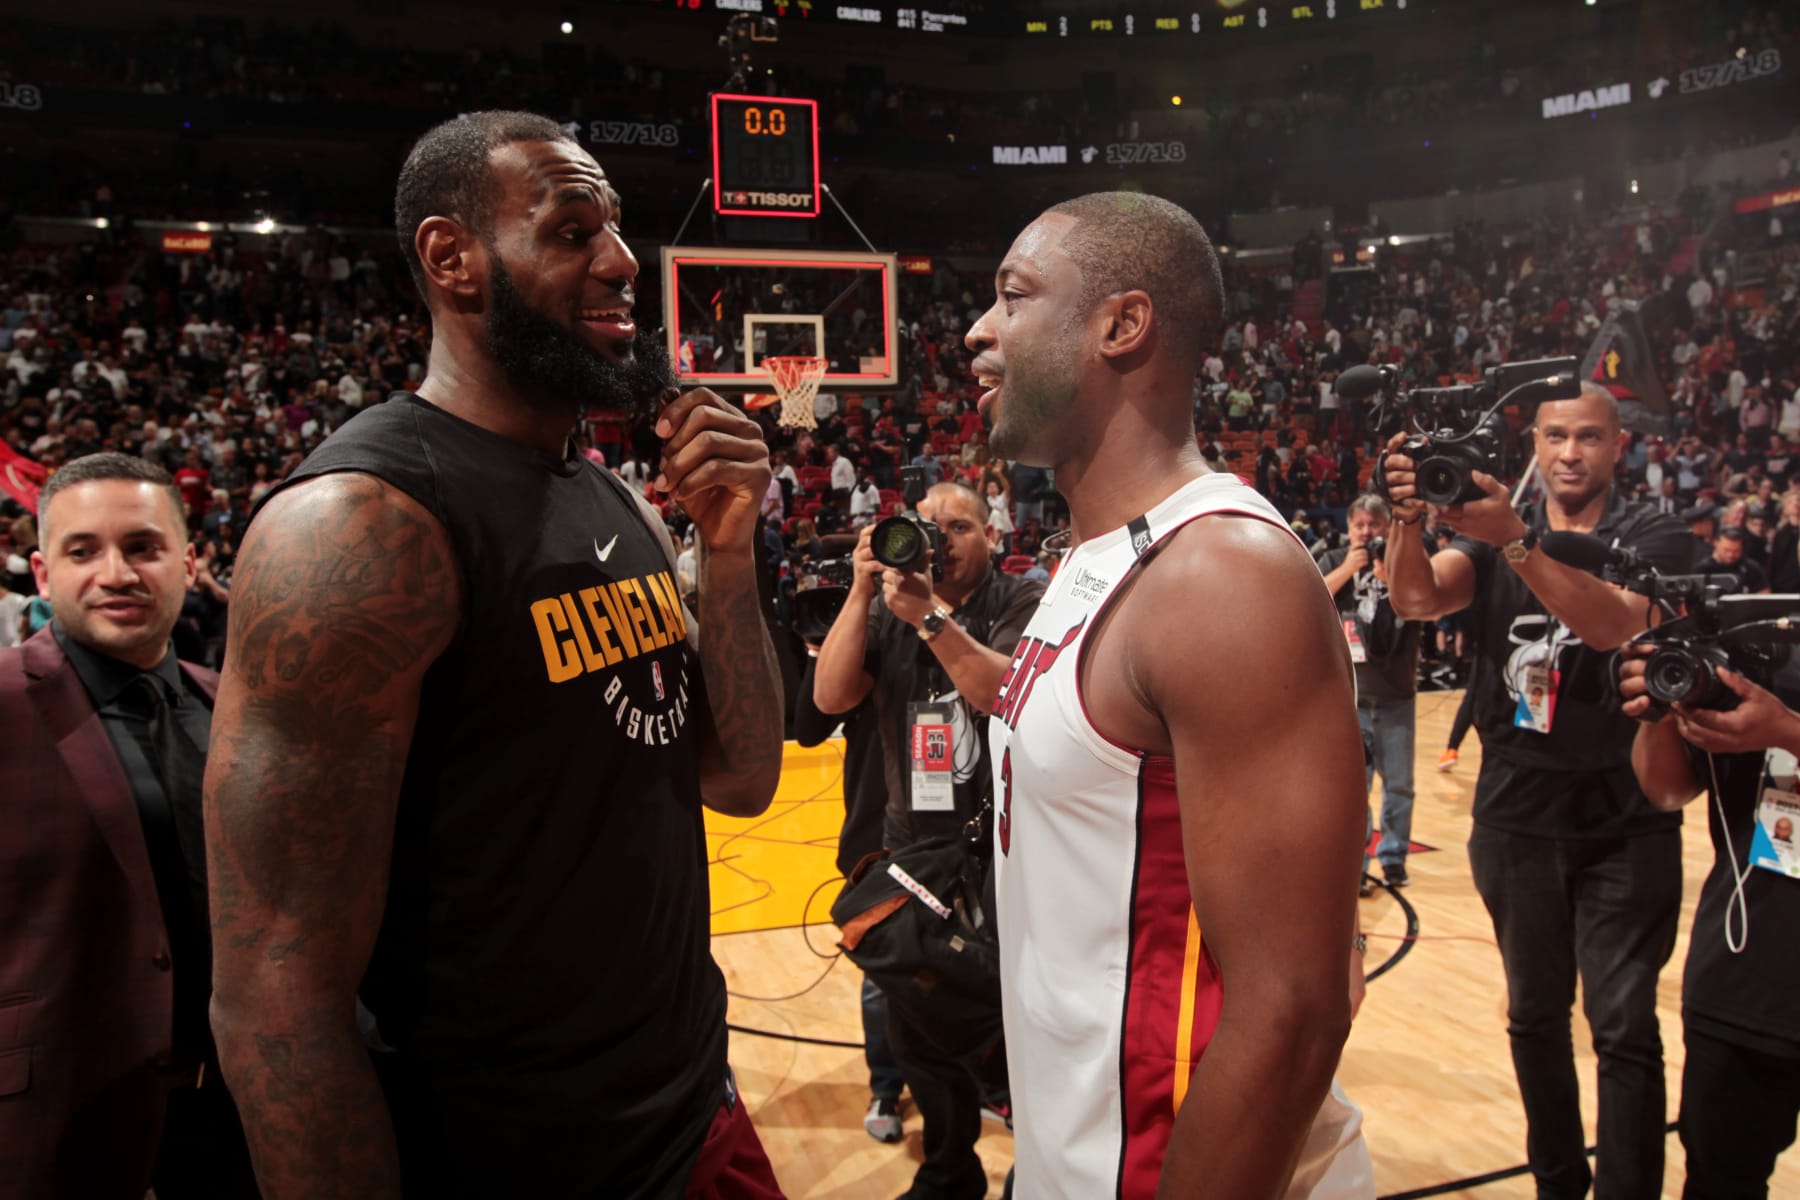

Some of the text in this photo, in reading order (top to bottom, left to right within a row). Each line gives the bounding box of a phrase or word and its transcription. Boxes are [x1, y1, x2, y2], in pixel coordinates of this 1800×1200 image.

[1027, 22, 1047, 32] MIN
[1091, 20, 1113, 31] PTS
[1542, 49, 1781, 119] MIAMI 17/18
[590, 120, 680, 146] 17/18
[745, 107, 786, 135] 0.0
[993, 142, 1186, 165] MIAMI 17/18
[748, 192, 812, 206] TISSOT
[1075, 567, 1108, 593] Ultimate
[991, 613, 1088, 732] EAT
